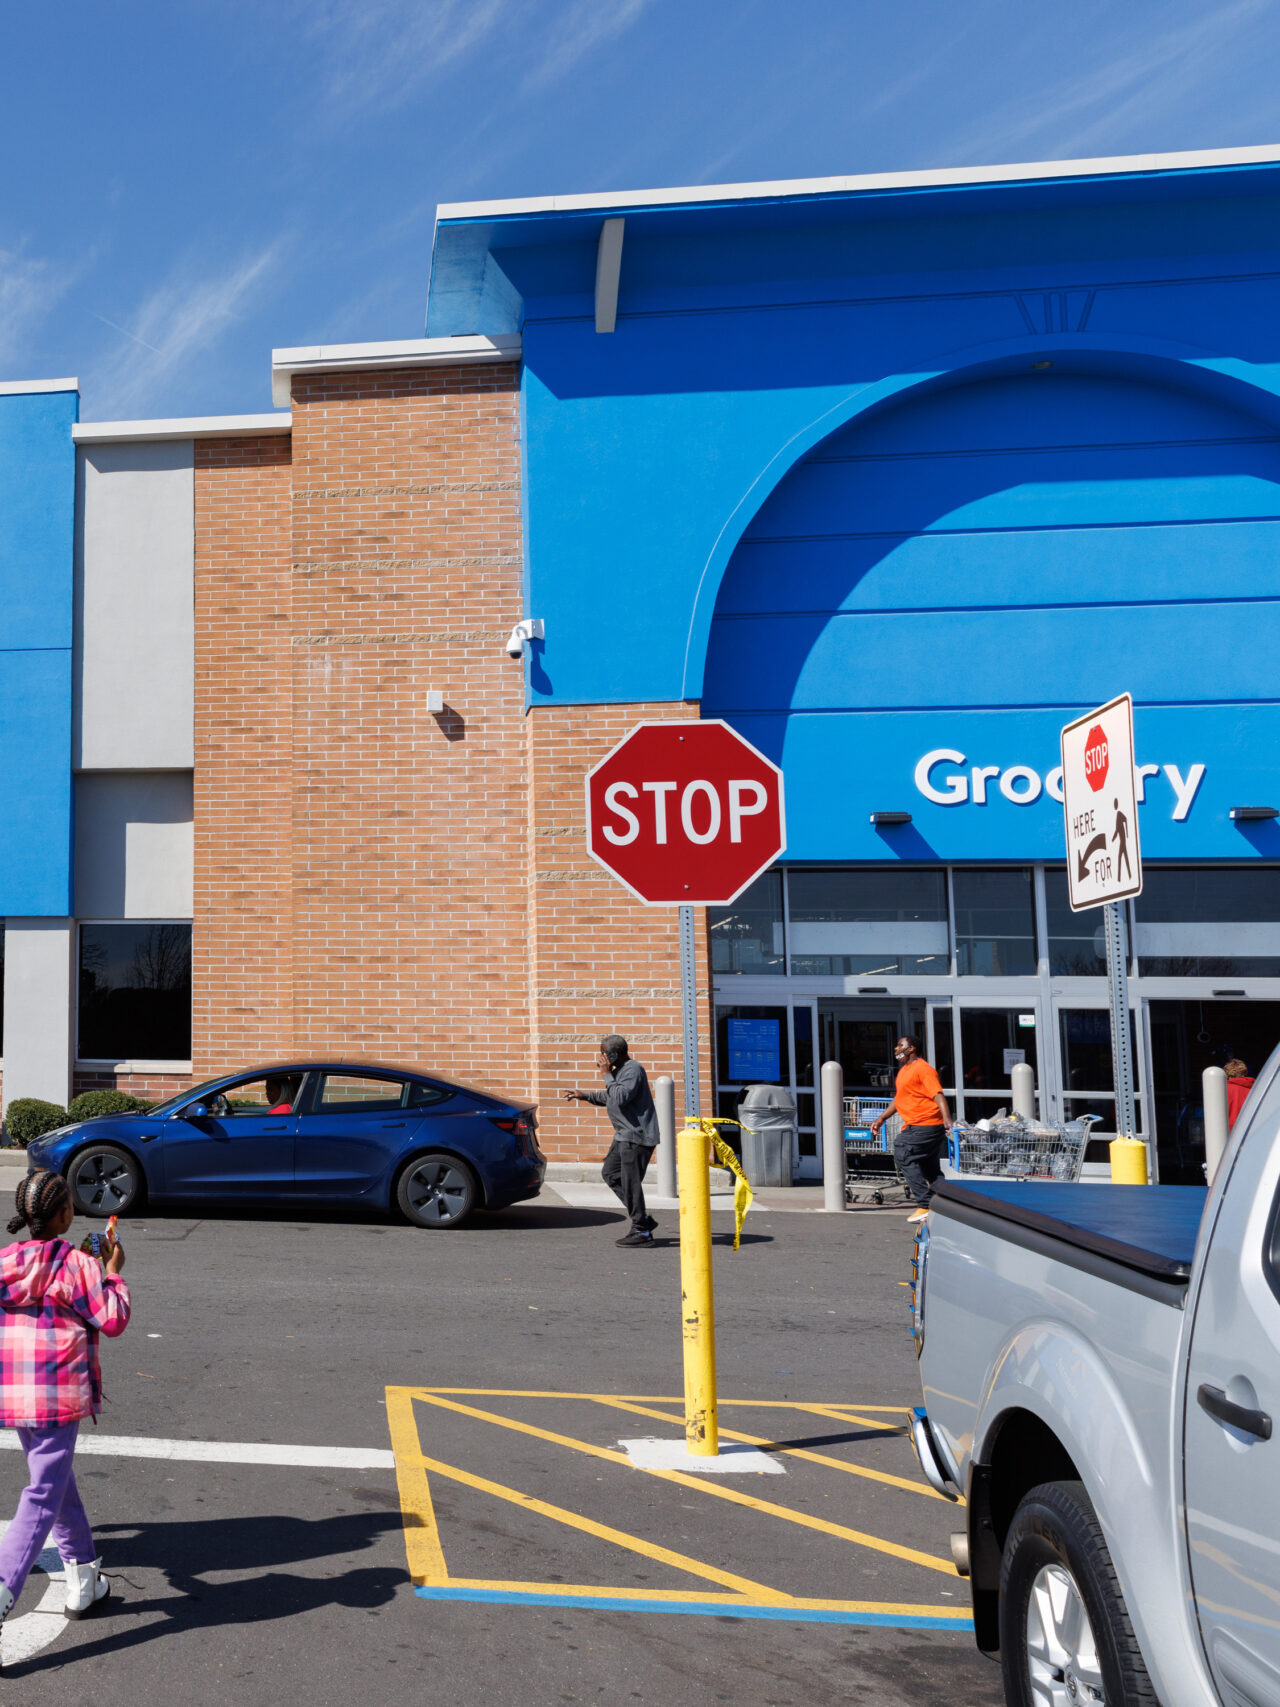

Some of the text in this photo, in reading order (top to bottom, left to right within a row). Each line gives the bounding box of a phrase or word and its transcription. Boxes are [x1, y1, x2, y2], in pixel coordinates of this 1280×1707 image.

[1085, 742, 1108, 775] STOP
[914, 748, 1206, 820] Grocry
[602, 779, 768, 846] STOP
[1073, 809, 1096, 839] HERE
[1095, 857, 1112, 883] FOR
